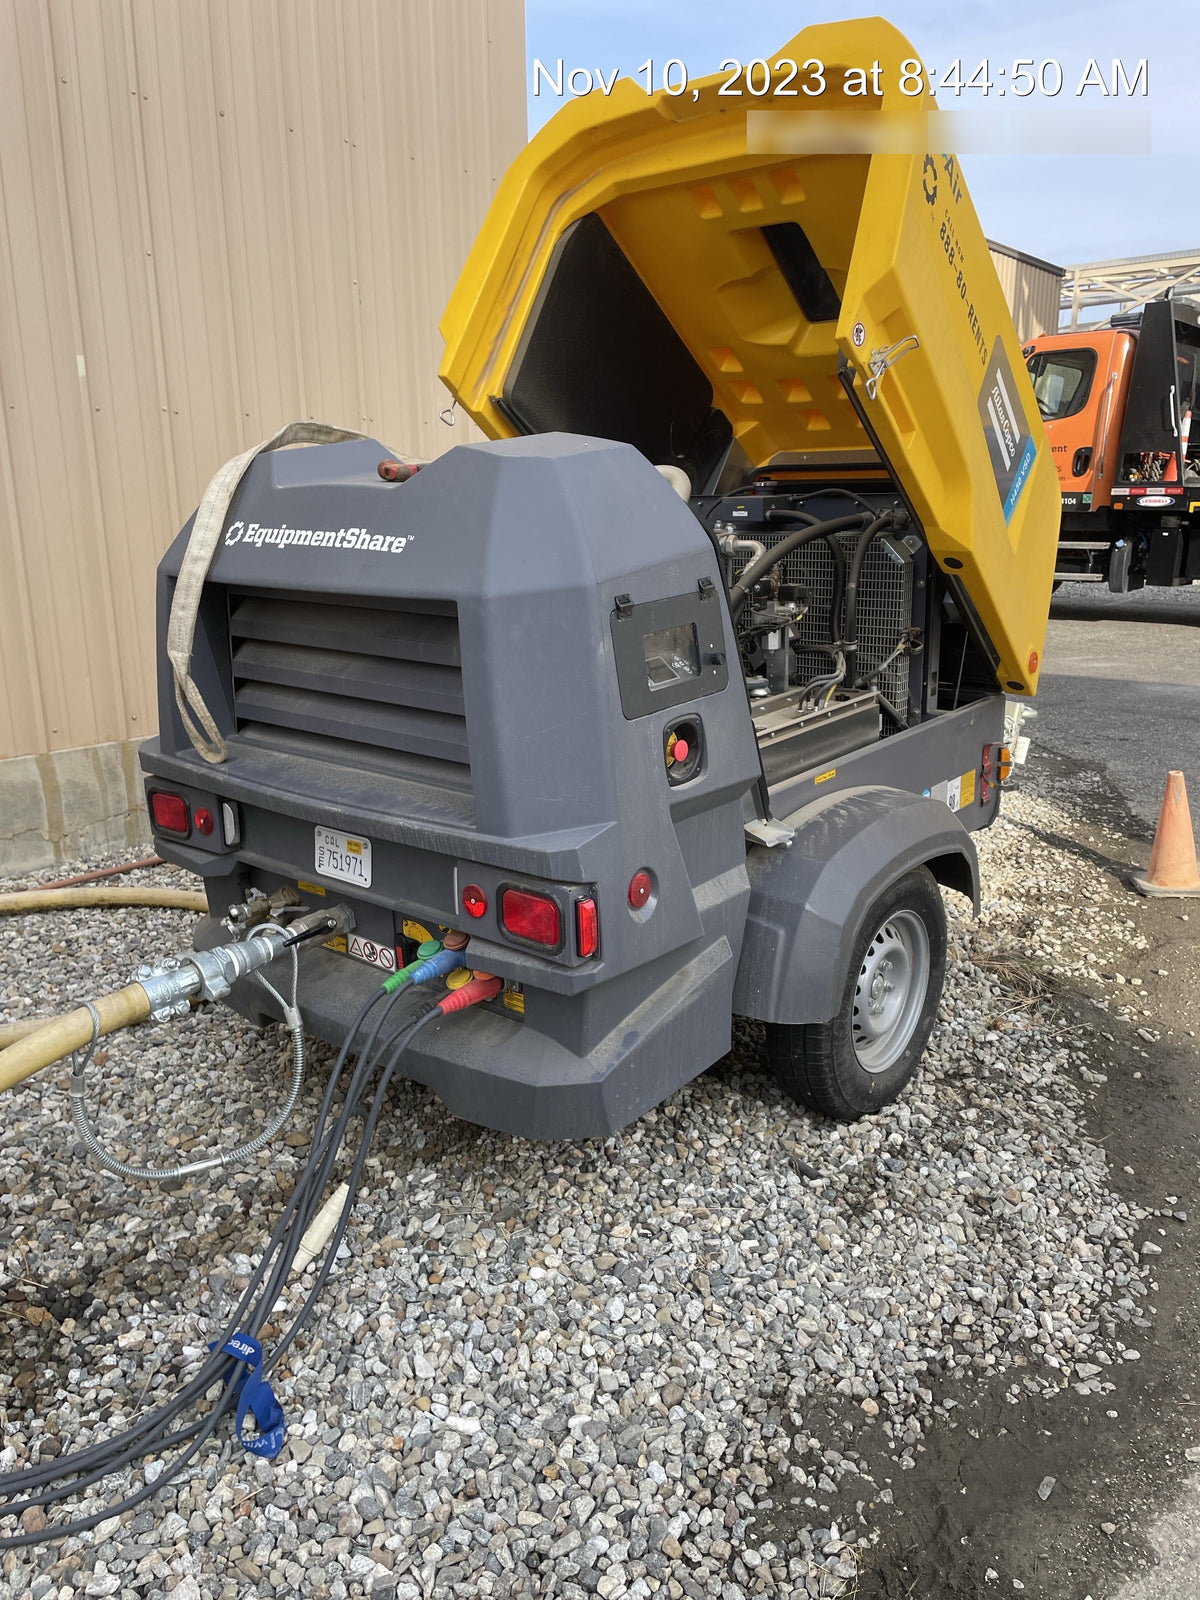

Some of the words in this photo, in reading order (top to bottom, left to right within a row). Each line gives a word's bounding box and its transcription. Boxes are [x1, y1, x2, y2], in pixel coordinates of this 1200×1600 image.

[943, 156, 963, 205] Air
[939, 221, 988, 366] 888-80-RENTS
[1020, 452, 1031, 476] VSD
[242, 523, 407, 554] EquipmentShare
[324, 835, 340, 848] CAL
[326, 848, 364, 878] 751971
